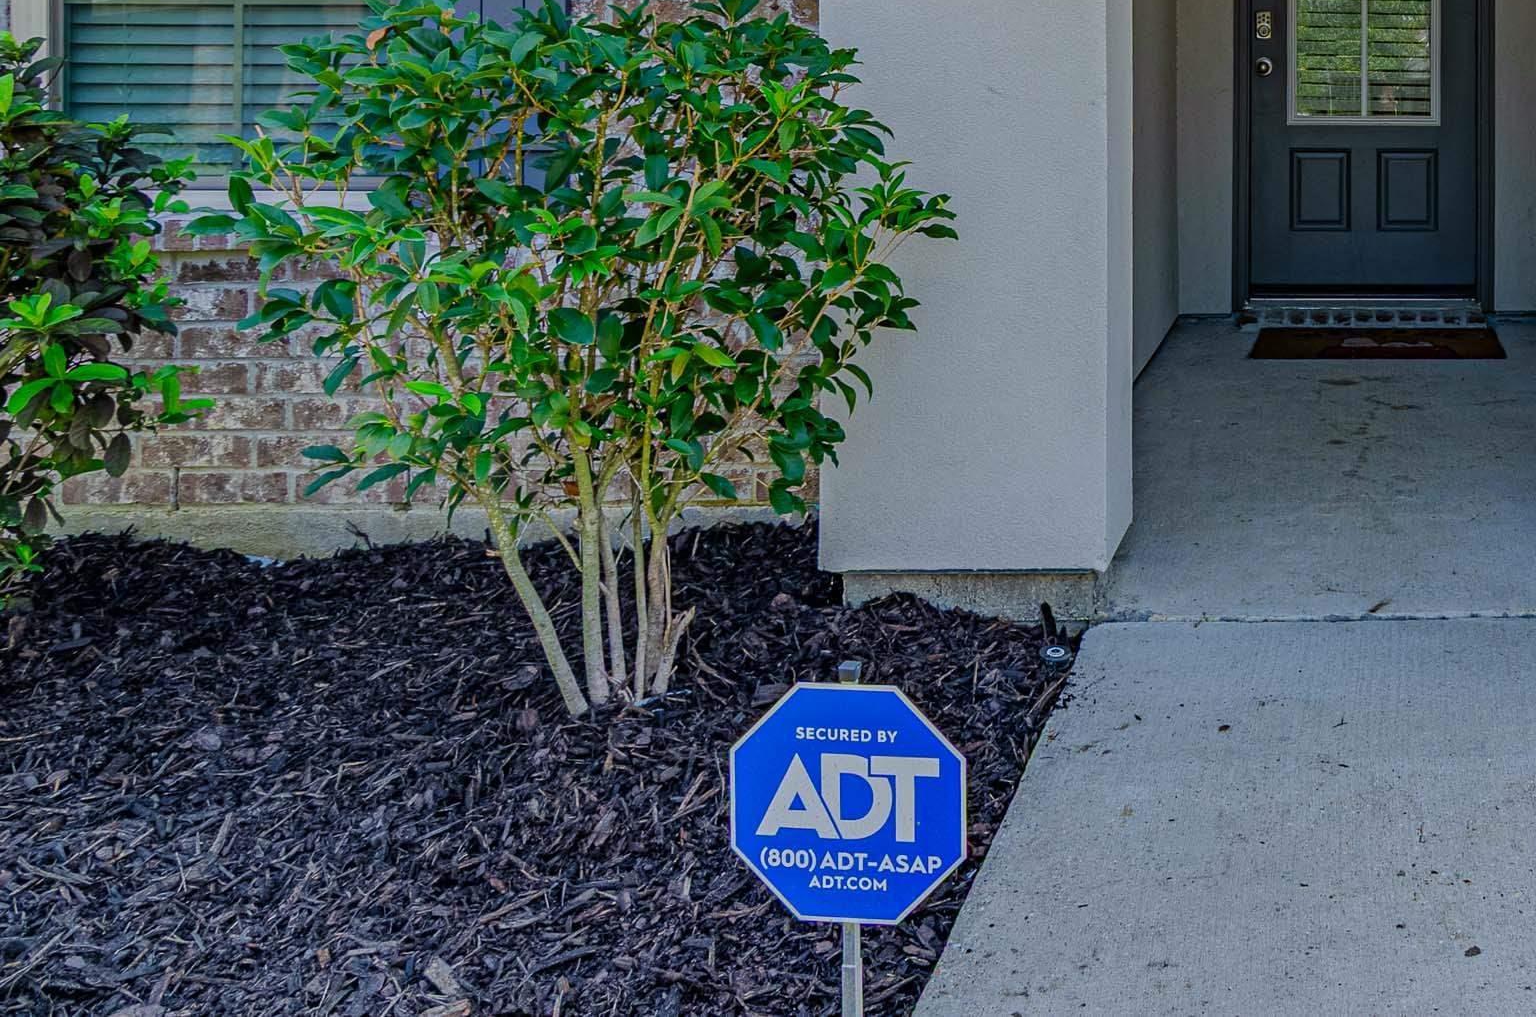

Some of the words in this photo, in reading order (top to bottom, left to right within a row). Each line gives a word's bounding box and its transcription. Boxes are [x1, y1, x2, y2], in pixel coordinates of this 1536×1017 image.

[795, 726, 872, 743] SECURED
[876, 730, 898, 744] BY
[755, 752, 940, 843] ADT
[759, 847, 817, 872] (800)
[820, 852, 942, 875] ADT-ASAP
[808, 876, 888, 892] ADT.COM
